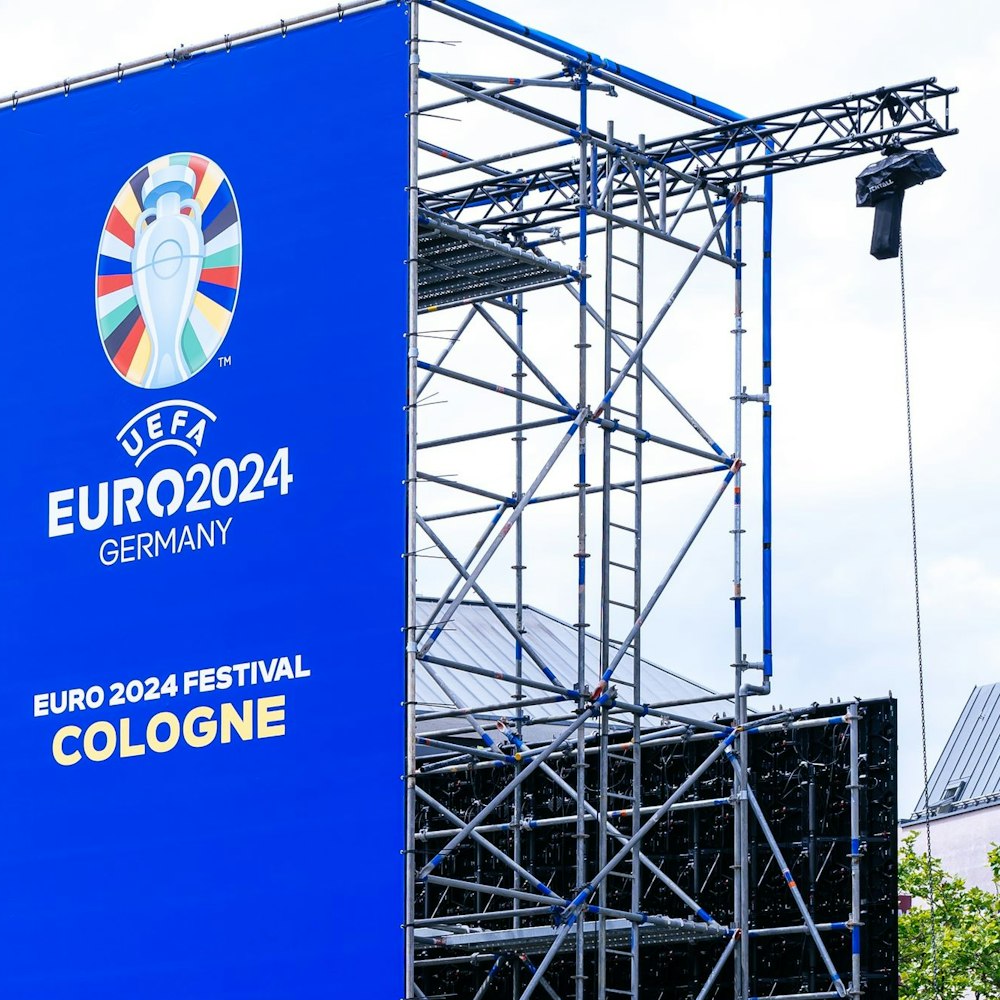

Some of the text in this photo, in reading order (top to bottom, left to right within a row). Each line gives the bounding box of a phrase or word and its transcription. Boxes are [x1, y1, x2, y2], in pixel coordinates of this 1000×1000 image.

[218, 355, 232, 367] TM
[121, 409, 207, 457] UEFA
[99, 517, 233, 566] GERMANY
[33, 654, 311, 717] EURO 2024 FESTIVAL
[52, 694, 286, 766] COLOGNE
